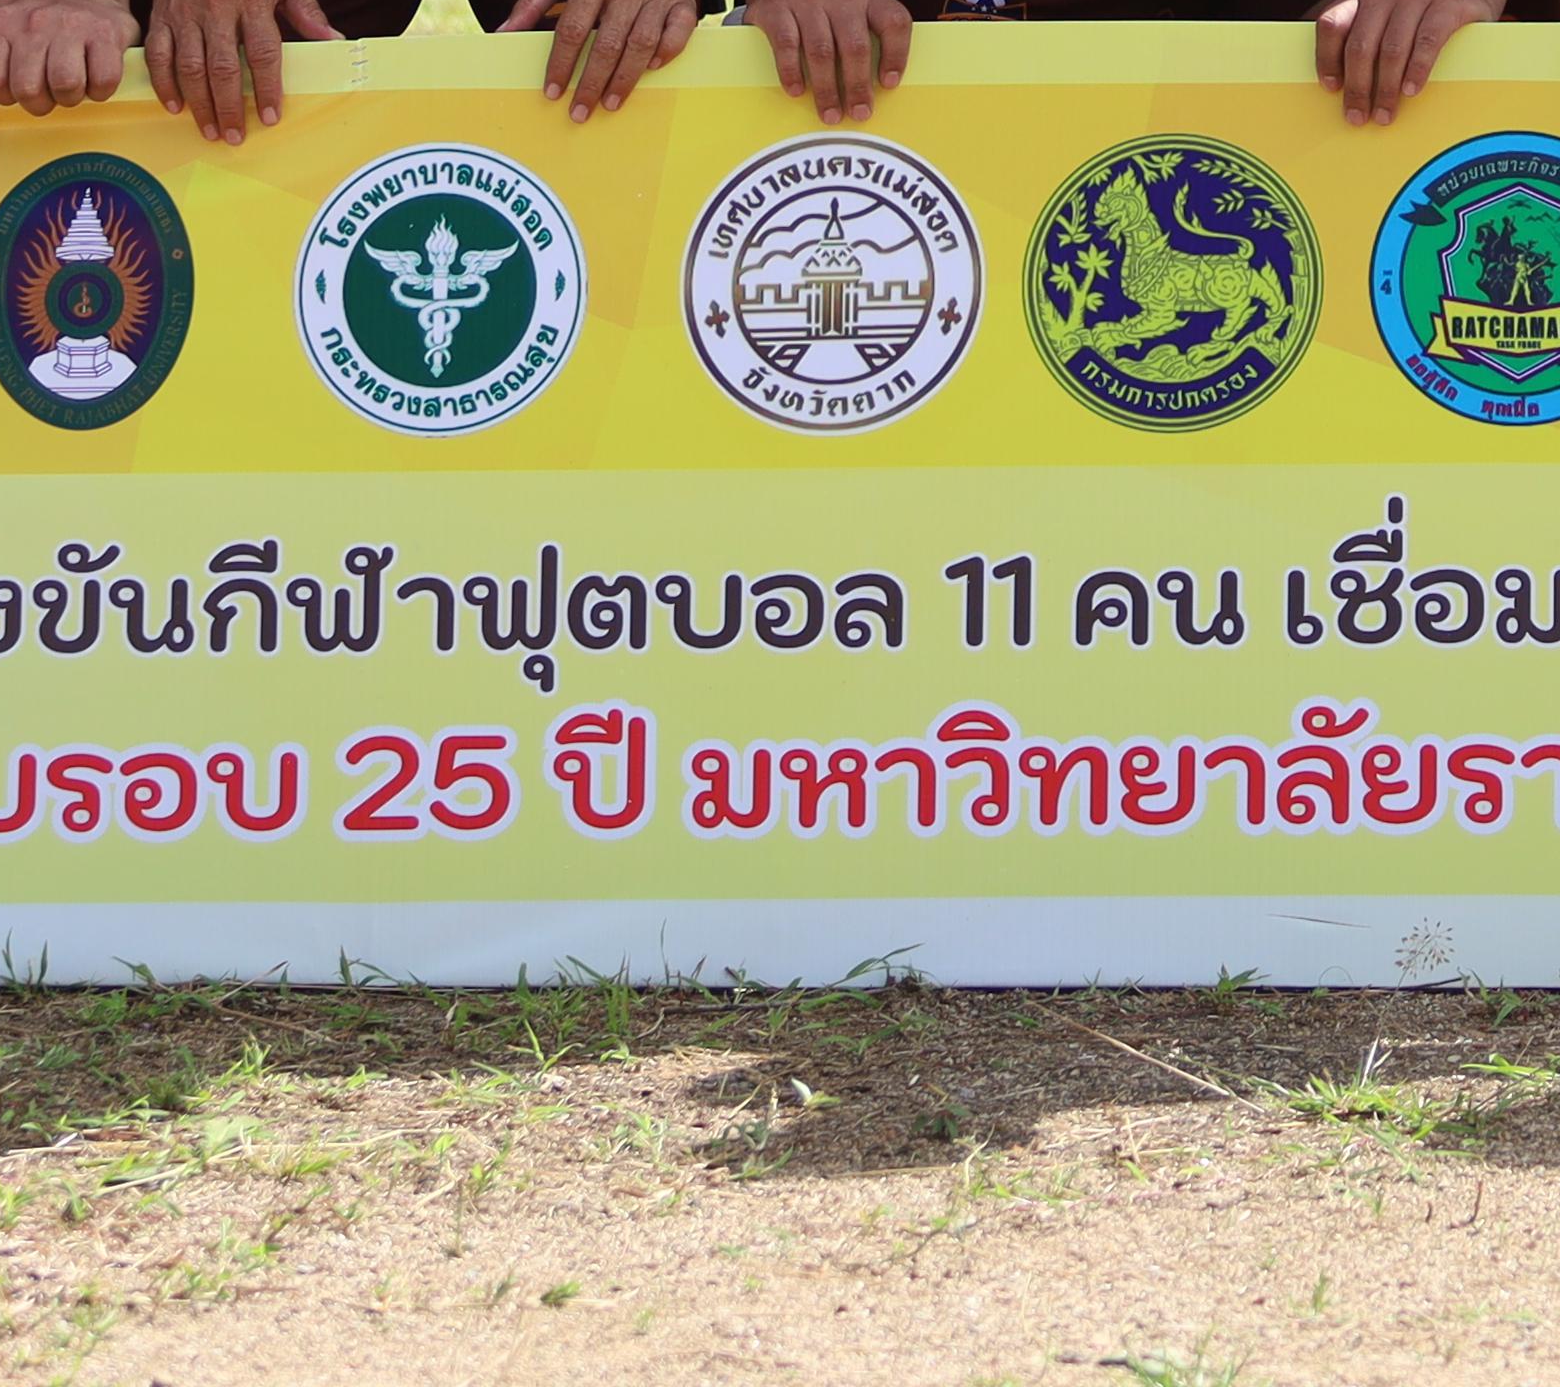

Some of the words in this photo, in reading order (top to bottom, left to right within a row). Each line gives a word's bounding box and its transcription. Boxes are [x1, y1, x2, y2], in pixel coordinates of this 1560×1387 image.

[317, 160, 555, 253] โรงพยาบาลแม่สอด
[707, 154, 960, 259] เทศบาลนครแม่สอด
[319, 324, 560, 419] กระทรวงสาธารณสุข
[742, 367, 917, 417] จังหวัดตาก
[1078, 361, 1261, 412] กรมการปกครอง
[944, 555, 1035, 649] 11
[1073, 568, 1244, 647] คน
[343, 735, 511, 830] 25
[552, 708, 647, 830] ปี
